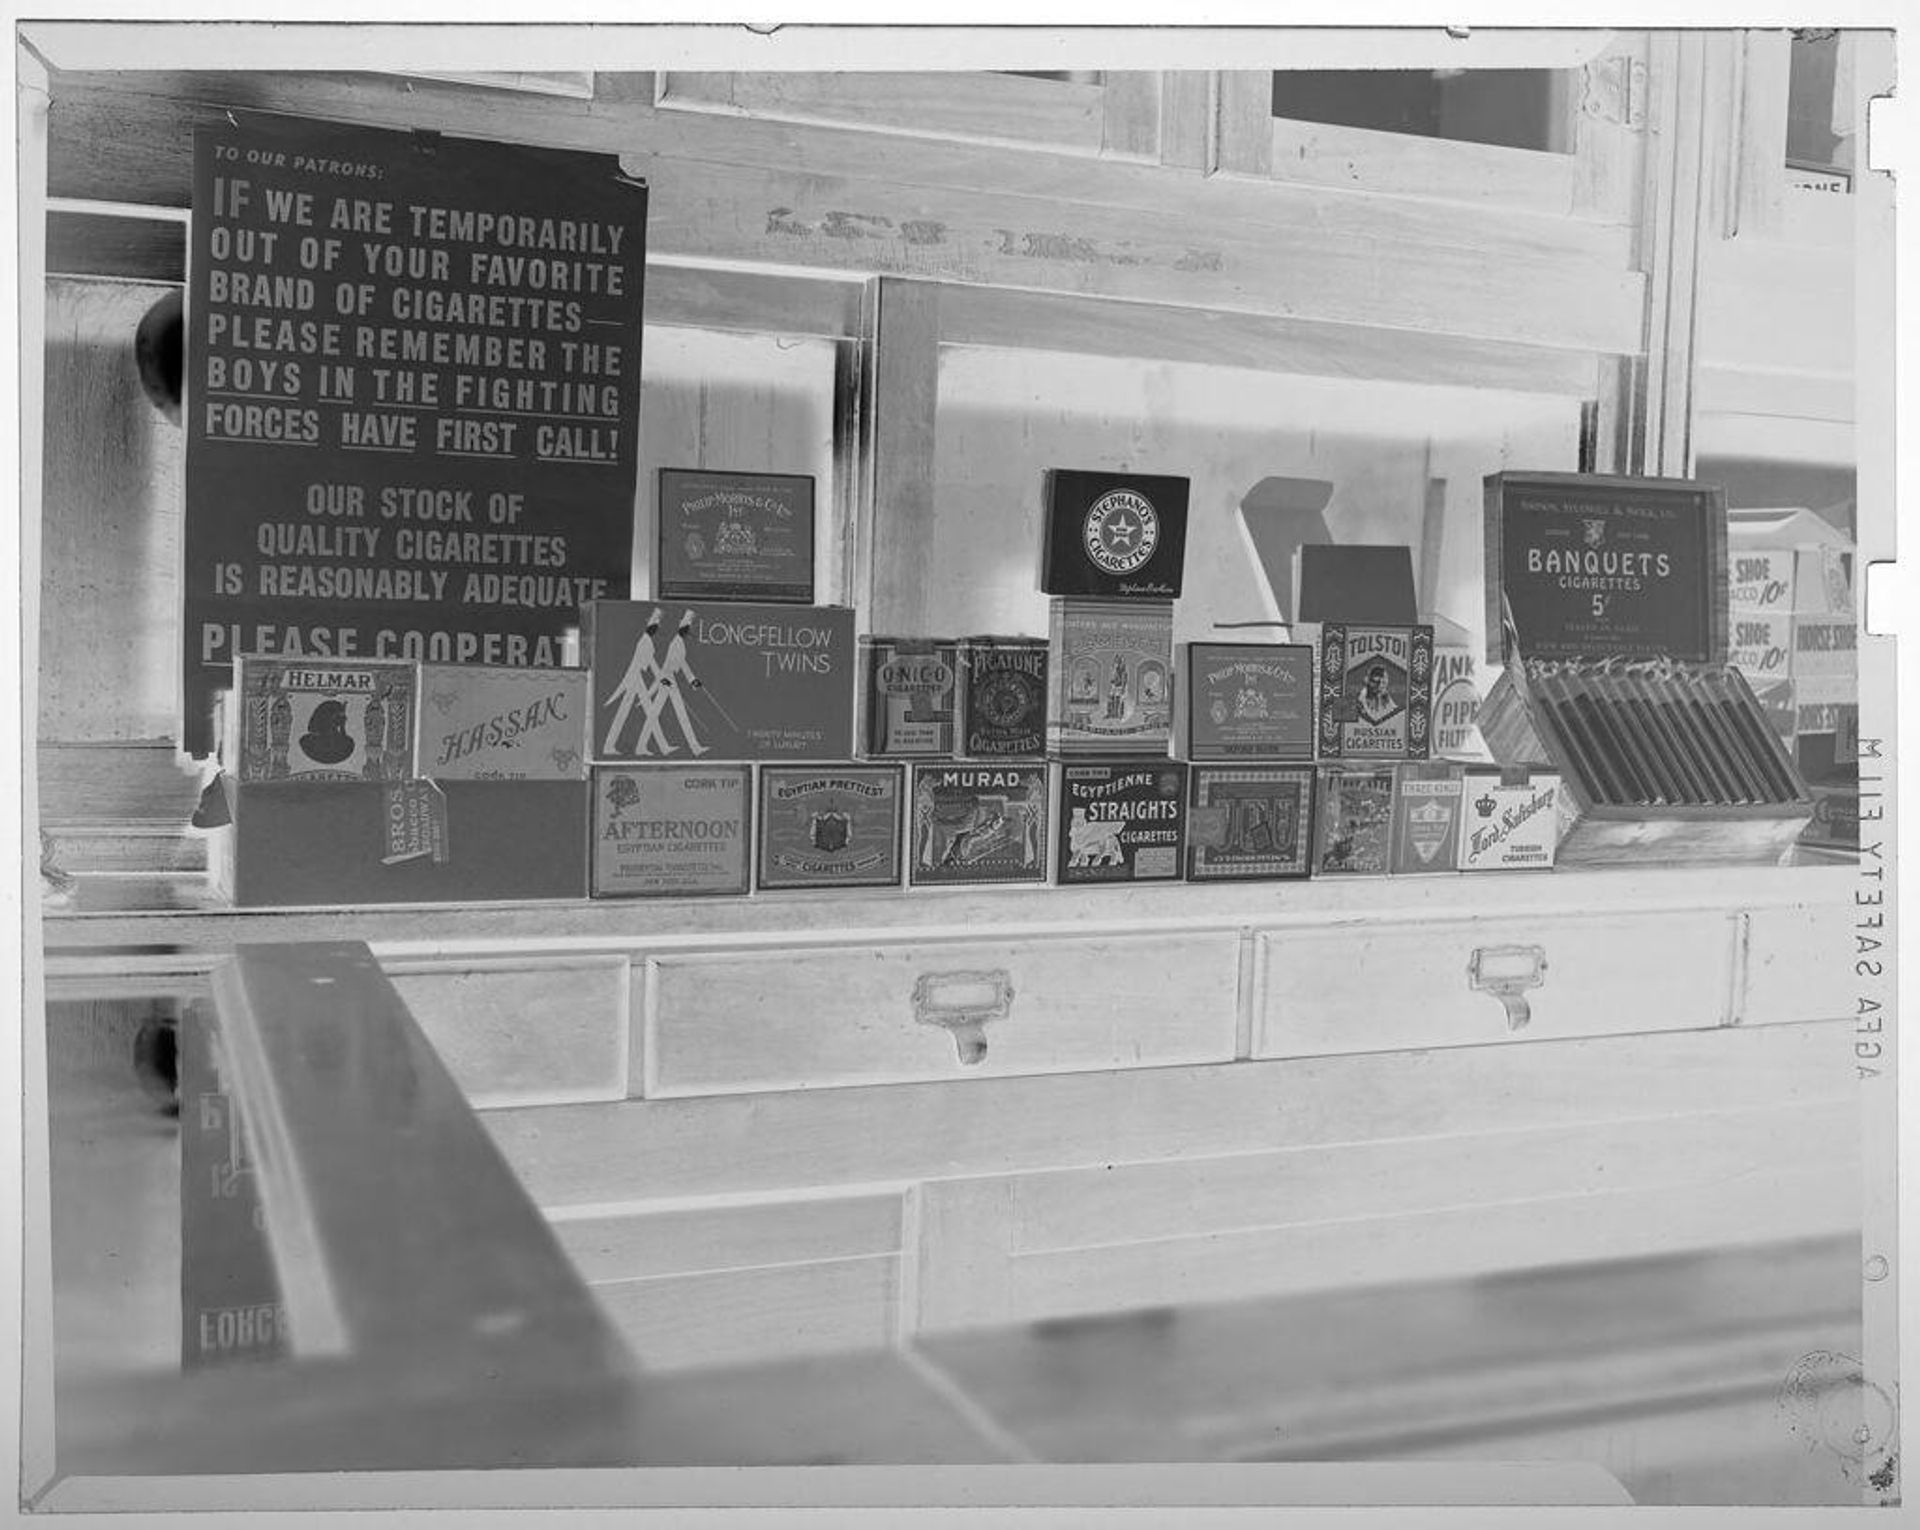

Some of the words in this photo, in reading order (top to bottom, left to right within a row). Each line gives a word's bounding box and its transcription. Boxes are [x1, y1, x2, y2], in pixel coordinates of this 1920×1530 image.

[214, 146, 239, 160] TO
[247, 150, 288, 168] OUR
[293, 156, 385, 181] PATRONS:
[214, 178, 251, 218] IF
[265, 189, 314, 226] WE
[331, 199, 393, 234] ARE
[409, 205, 625, 256] TEMPORARILY
[211, 227, 279, 264] OUT
[301, 237, 342, 271] OF
[363, 244, 449, 281] YOUR
[471, 254, 625, 296] FAVORITE
[209, 270, 315, 310] BRAND
[336, 283, 375, 316] OF
[208, 313, 342, 357] PLEASE
[356, 327, 547, 372] REMEMBER
[561, 342, 622, 377] THE
[208, 357, 301, 394] BOYS
[319, 366, 354, 398] IN
[373, 369, 439, 404] THE
[456, 375, 619, 415] FIGHTING
[206, 403, 320, 441] FORCES
[341, 413, 417, 448] HAVE
[437, 419, 516, 453] FIRST
[536, 427, 619, 459] CALL!
[307, 484, 364, 517] OUR
[380, 487, 473, 522] STOCK
[489, 493, 525, 523] OF
[257, 523, 380, 558] QUALITY
[397, 530, 567, 567] CIGARETTES
[1089, 537, 1152, 570] CIGARETTES
[1528, 548, 1670, 577] BANQUETS
[1736, 557, 1770, 583] SHOE
[215, 563, 242, 596] IS
[260, 564, 449, 603] REASONABLY
[464, 574, 607, 607] ADEQUATE
[1559, 576, 1641, 590] CIGARETTES
[202, 623, 358, 661] PLEASE
[699, 619, 832, 648] LONGFELLOW
[1349, 634, 1406, 659] TOLSTOI
[1736, 622, 1770, 647] SHOE
[761, 651, 830, 677] TWINS
[287, 671, 373, 690] HELMAR
[436, 692, 569, 765] HASSAN
[969, 733, 1042, 753] CIGARETTES
[1346, 737, 1403, 750] CIGARETTES
[777, 780, 827, 798] EGYPTIAN
[829, 780, 884, 797] PRETTIEST
[942, 772, 1020, 787] MURAD
[1072, 774, 1153, 798] EGYPTIENNE
[1089, 801, 1178, 820] STRAIGHTS
[603, 819, 740, 841] AFTERNOON
[1120, 830, 1178, 843] CIGARETTES
